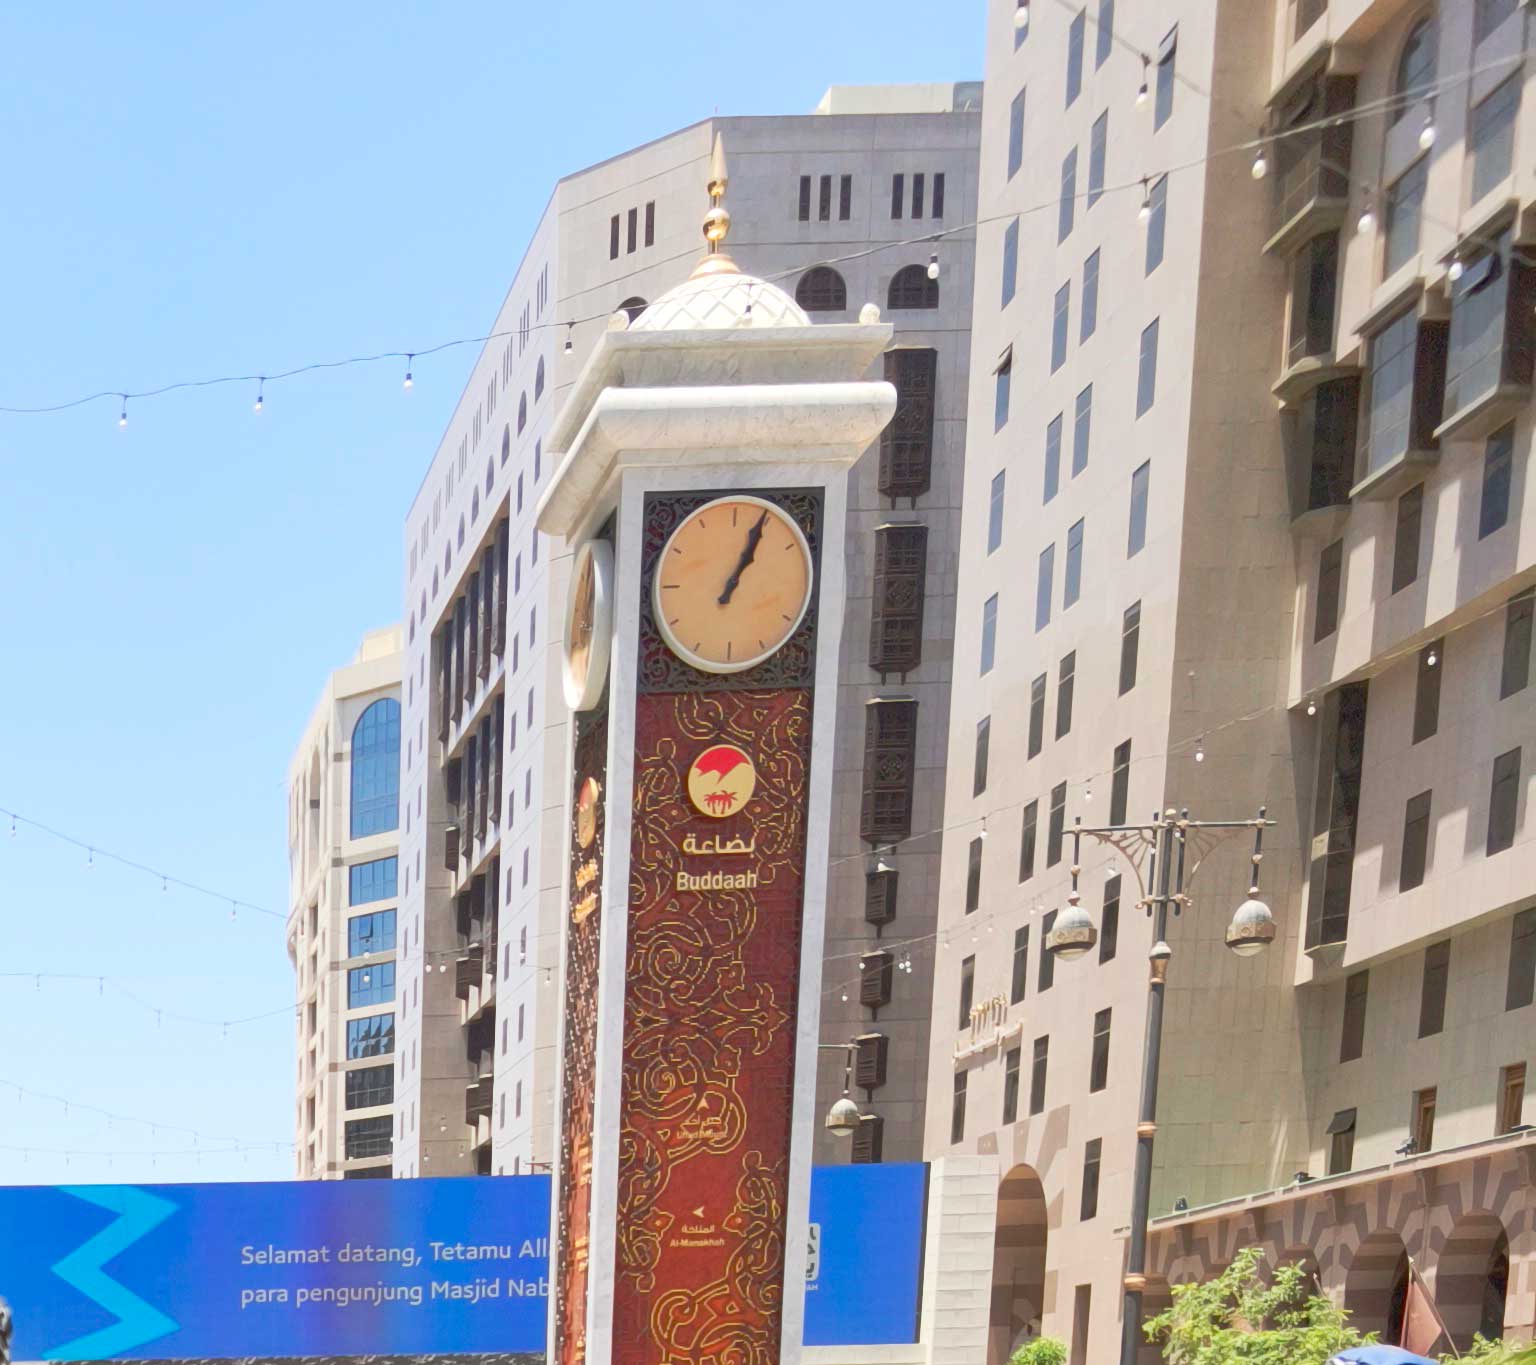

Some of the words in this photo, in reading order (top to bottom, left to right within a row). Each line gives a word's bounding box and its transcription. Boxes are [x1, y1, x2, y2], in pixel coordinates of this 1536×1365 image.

[682, 833, 756, 859] بضاعة
[676, 870, 758, 891] Buddaah
[240, 1244, 332, 1265] Selamat
[337, 1243, 422, 1267] datang,
[430, 1241, 512, 1261] Tetamu
[519, 1238, 548, 1259] All
[240, 1288, 289, 1309] para
[296, 1281, 423, 1309] pengunjung
[430, 1278, 501, 1304] Masjid
[507, 1278, 549, 1298] Nab
